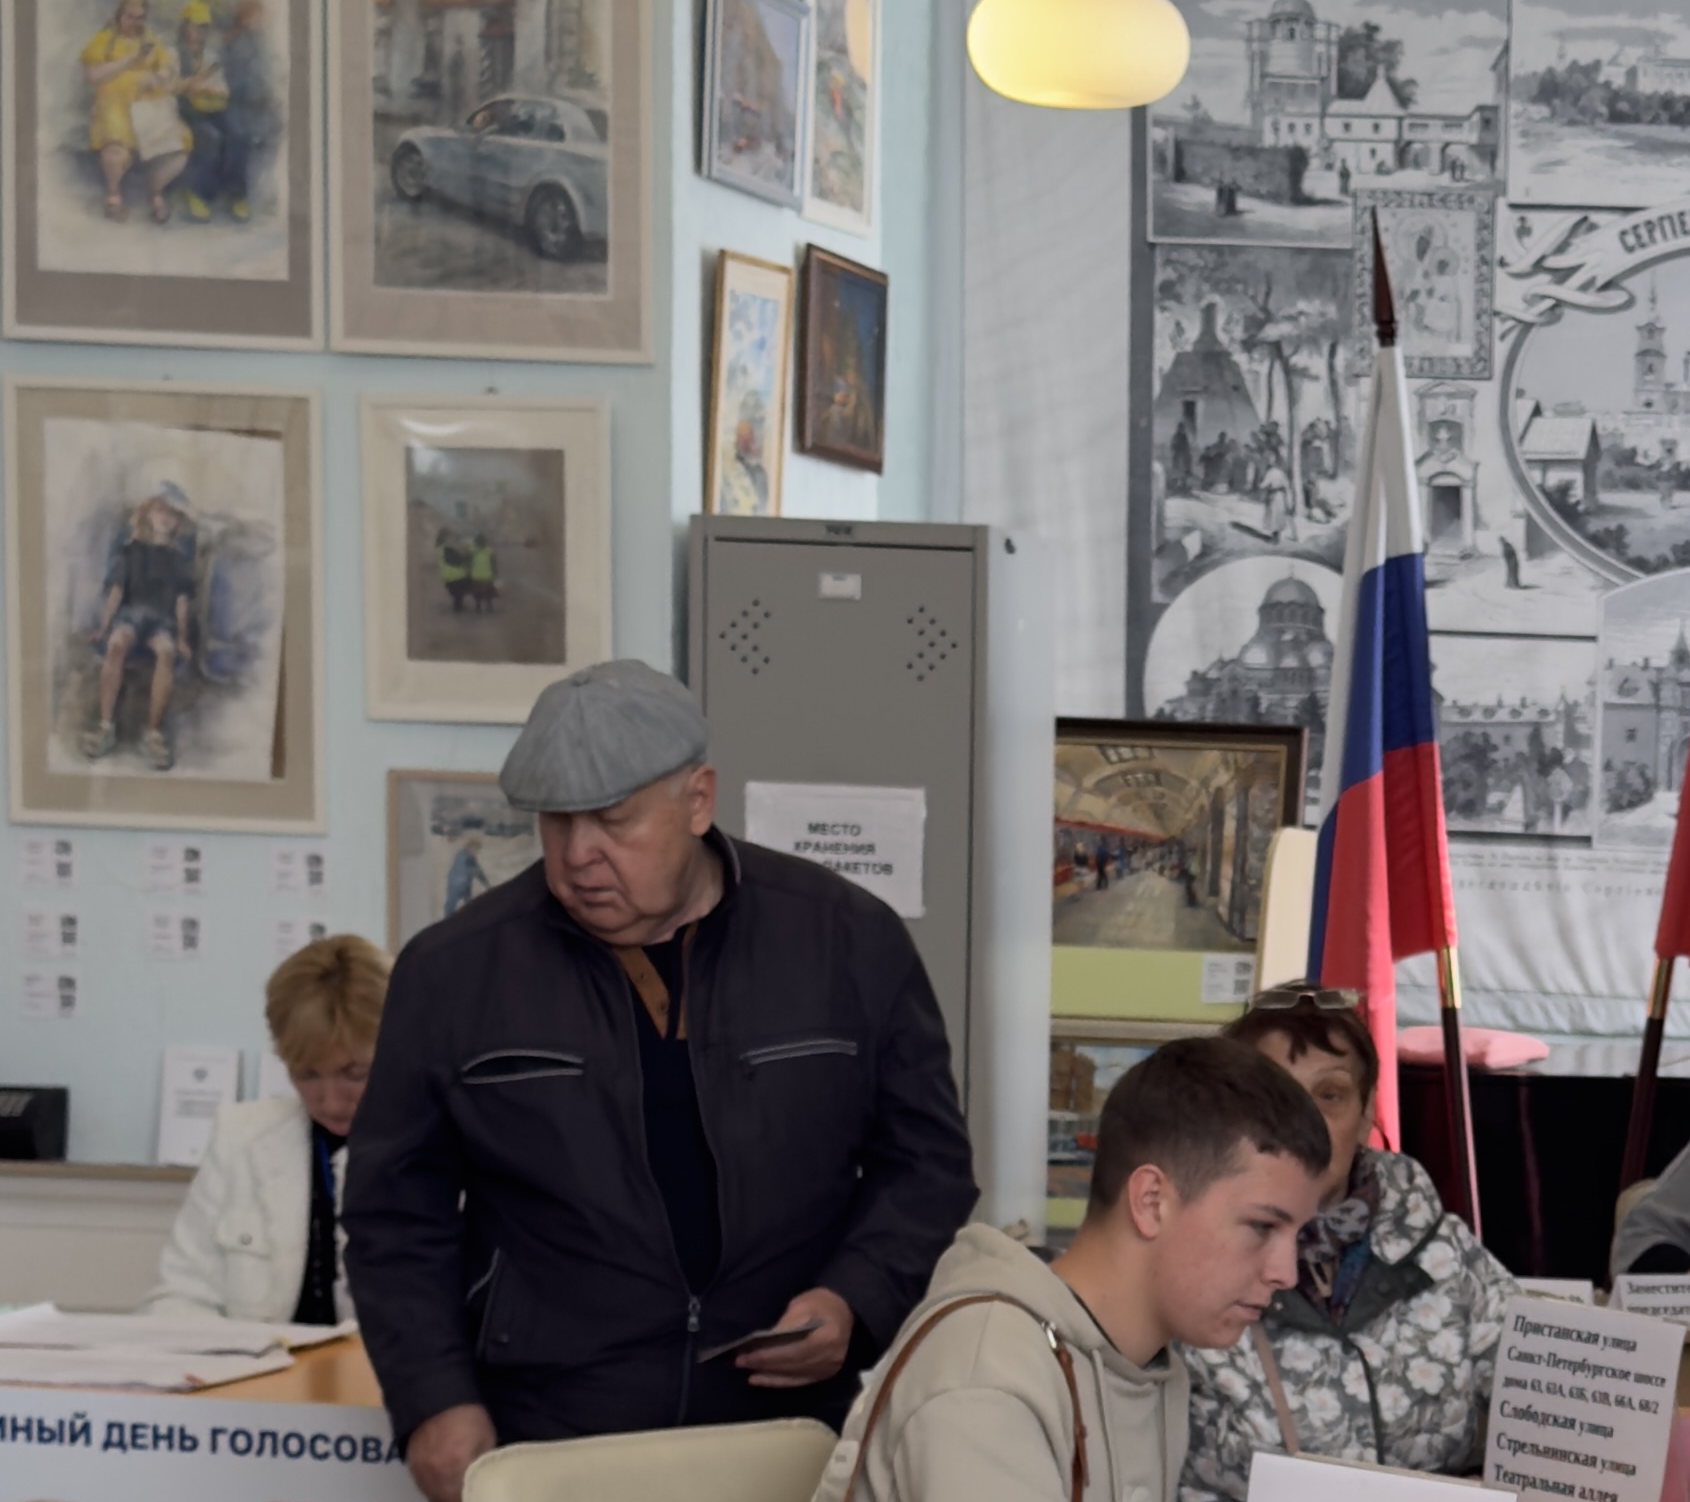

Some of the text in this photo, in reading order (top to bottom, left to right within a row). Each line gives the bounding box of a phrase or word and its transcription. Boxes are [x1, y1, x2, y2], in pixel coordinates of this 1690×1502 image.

[794, 841, 876, 855] ХРАНЕНИЯ
[808, 823, 861, 836] МЕСТО
[1513, 1315, 1637, 1353] Пристанская улица
[1503, 1376, 1527, 1390] дома
[1508, 1346, 1666, 1387] Санкт-Петербургское шоссе
[1500, 1400, 1614, 1438] Слободская улица
[102, 1422, 199, 1454] ДЕНЬ
[210, 1428, 406, 1465] ГОЛОСОВА
[1497, 1432, 1636, 1476] Стрельнинская улица
[1494, 1463, 1574, 1498] Театральная
